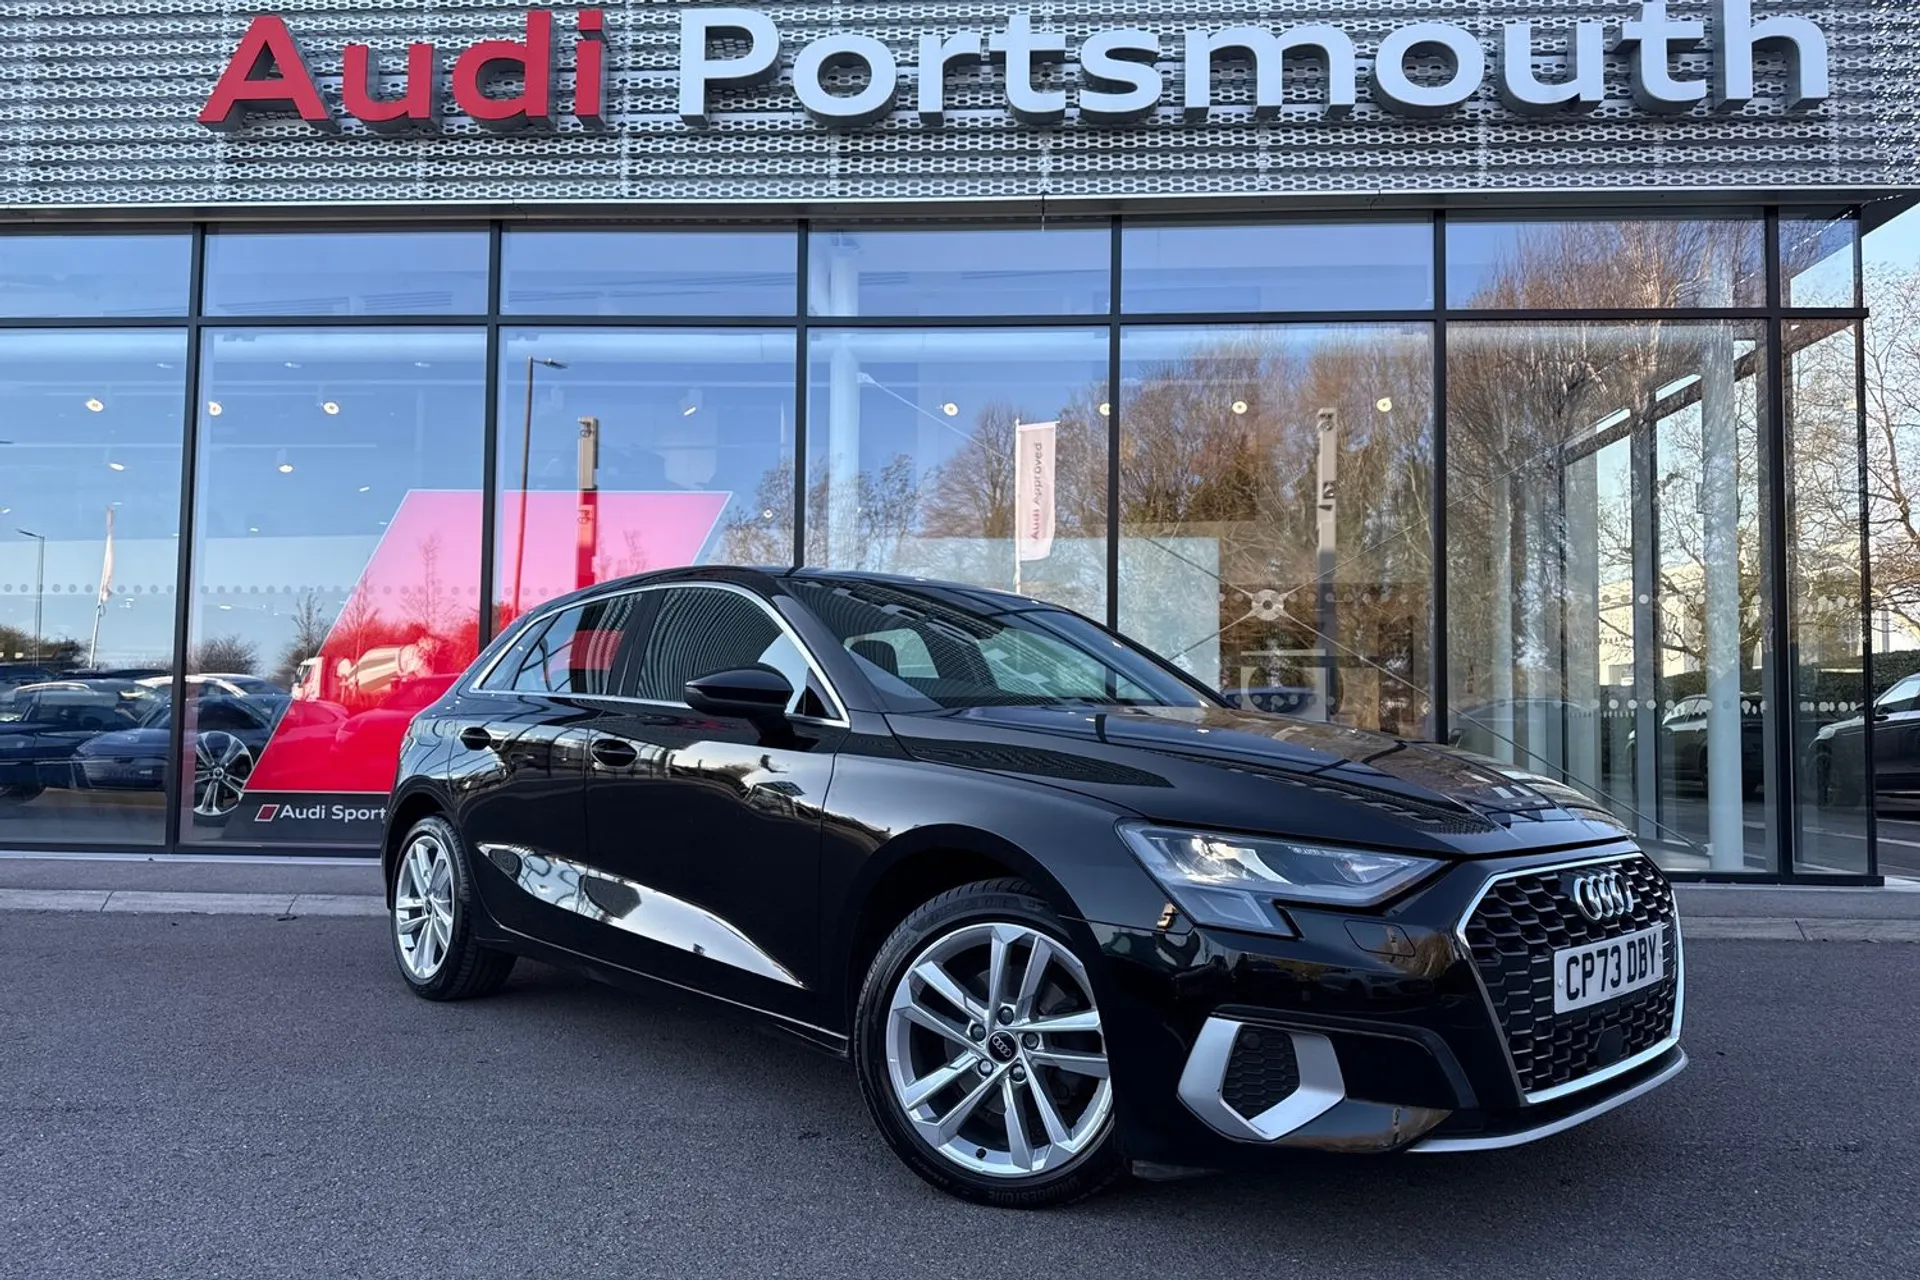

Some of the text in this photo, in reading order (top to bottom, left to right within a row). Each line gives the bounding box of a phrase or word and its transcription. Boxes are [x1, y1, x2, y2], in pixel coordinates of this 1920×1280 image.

[198, 0, 1829, 126] Audi Portsmouth
[1030, 442, 1043, 540] Audi Approved
[279, 805, 387, 823] Audi Sport
[1565, 932, 1657, 1001] CP73 DBY
